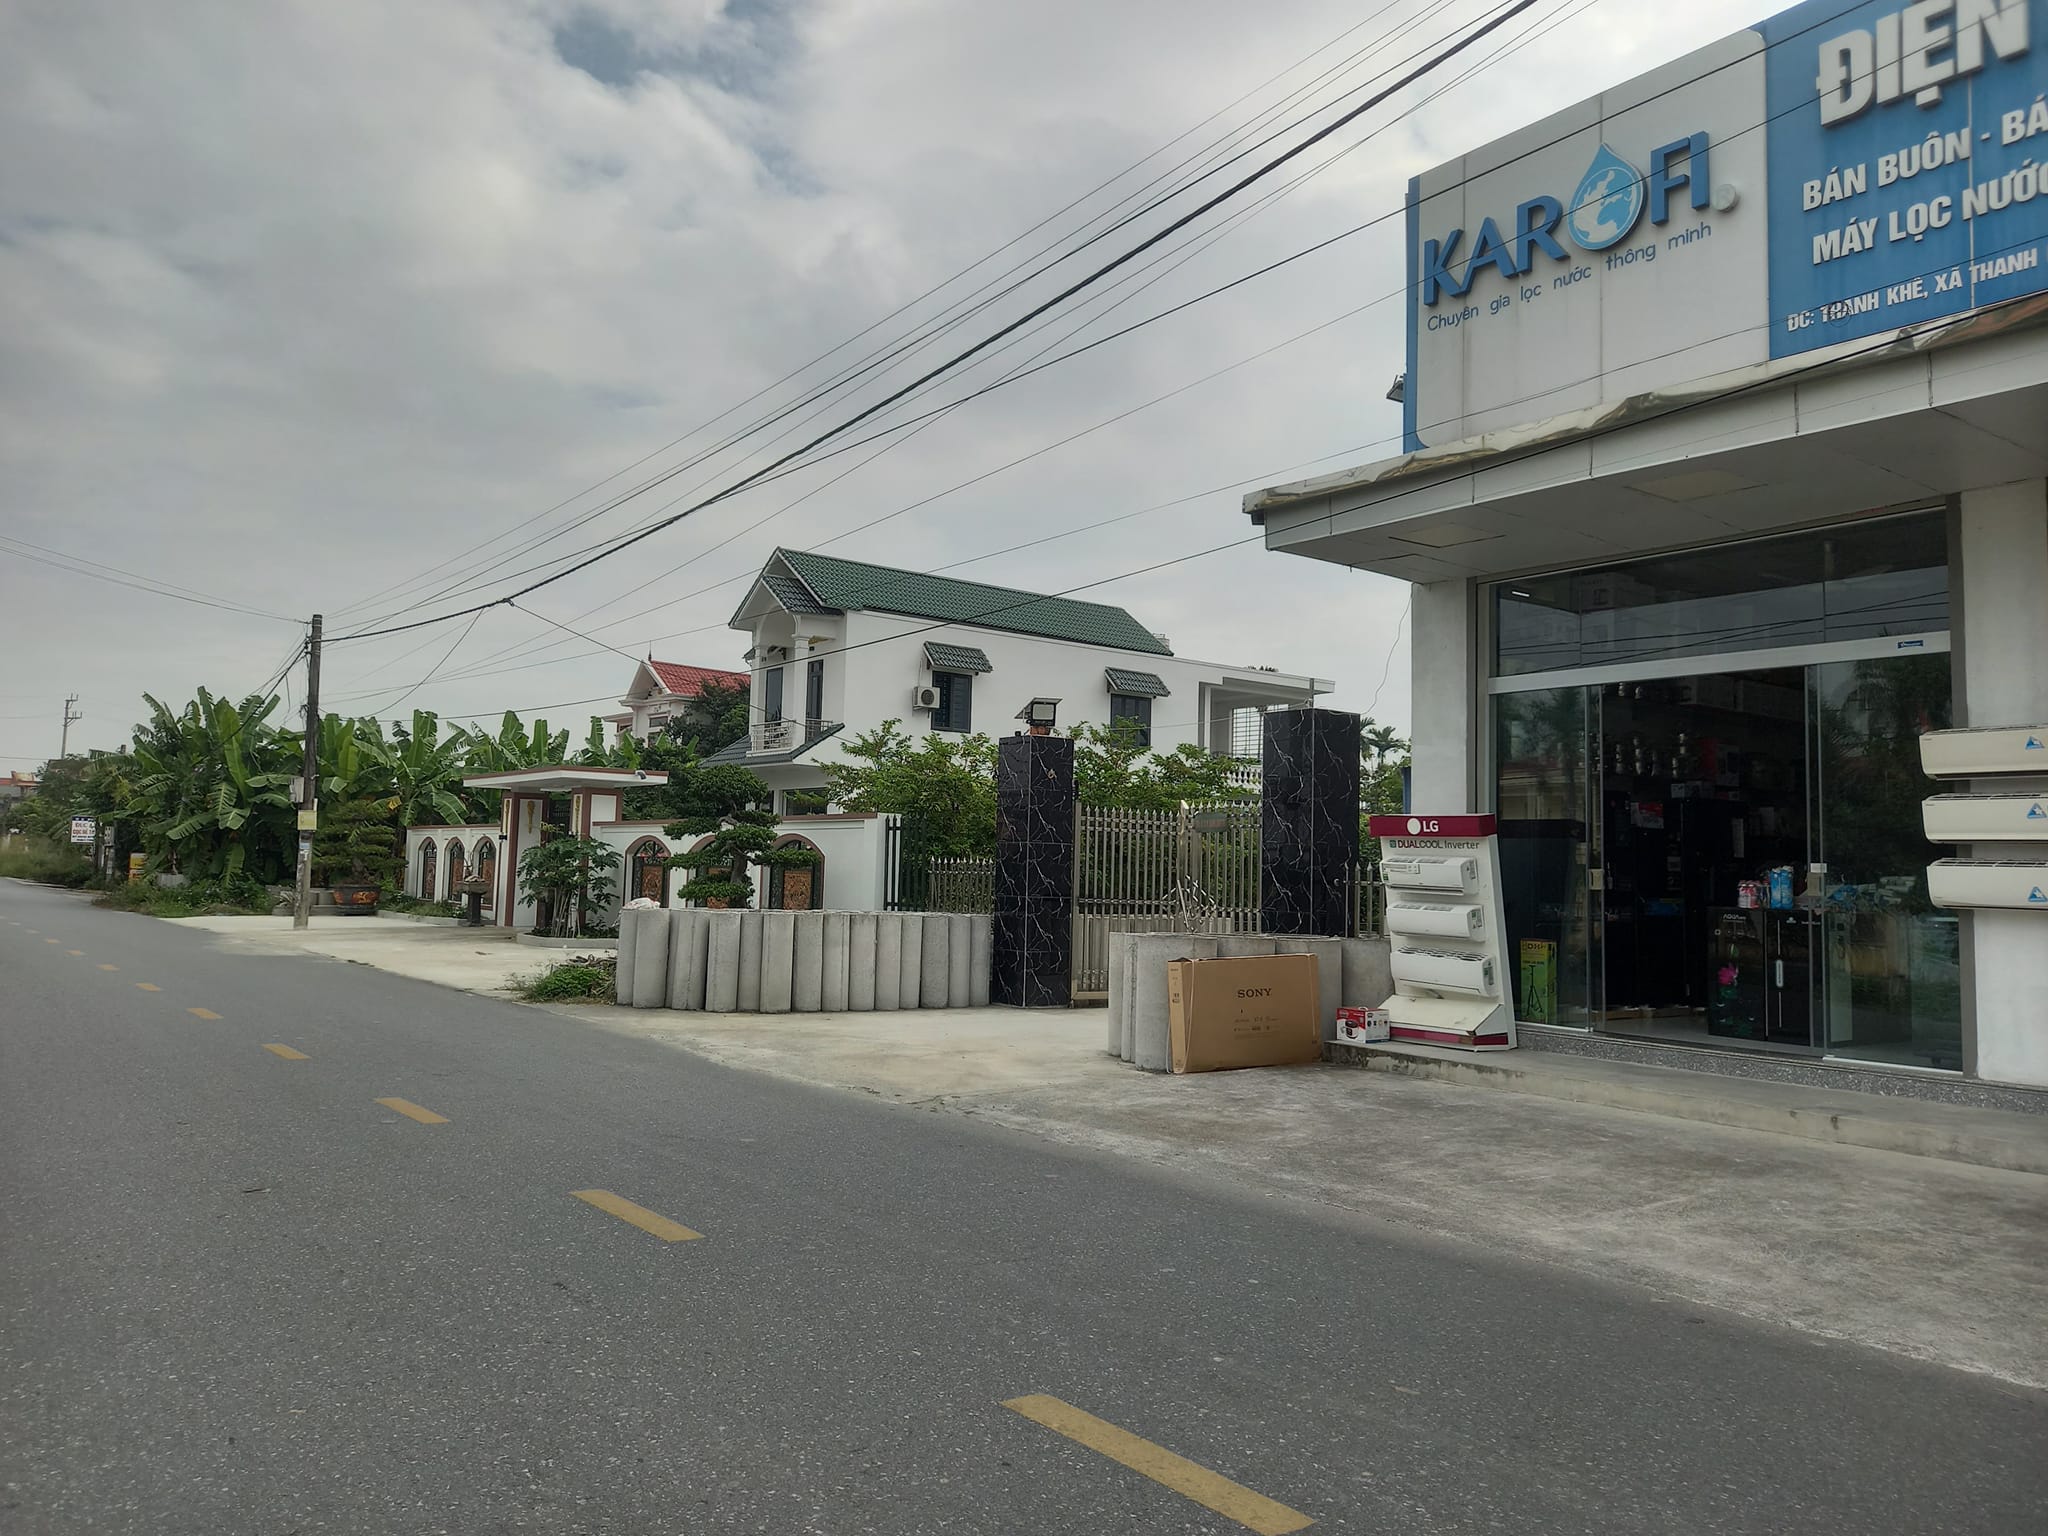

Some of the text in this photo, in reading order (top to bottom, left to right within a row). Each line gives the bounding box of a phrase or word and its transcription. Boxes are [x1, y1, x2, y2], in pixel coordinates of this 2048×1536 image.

[1803, 163, 1867, 211] BÁN
[1877, 127, 1970, 187] BUÔN
[1812, 216, 1879, 265] MÁY
[1888, 195, 1953, 242] LỌC
[1427, 221, 1712, 331] Chuyên gia lọc nước thông minh
[1787, 312, 1815, 332] ĐC:
[1887, 277, 1929, 306] KHÊ,
[1934, 267, 1963, 294] XÃ
[1969, 247, 2038, 284] THANH
[1422, 820, 1439, 832] LG
[1444, 840, 1480, 850] Inverter
[1237, 988, 1272, 999] SONY
